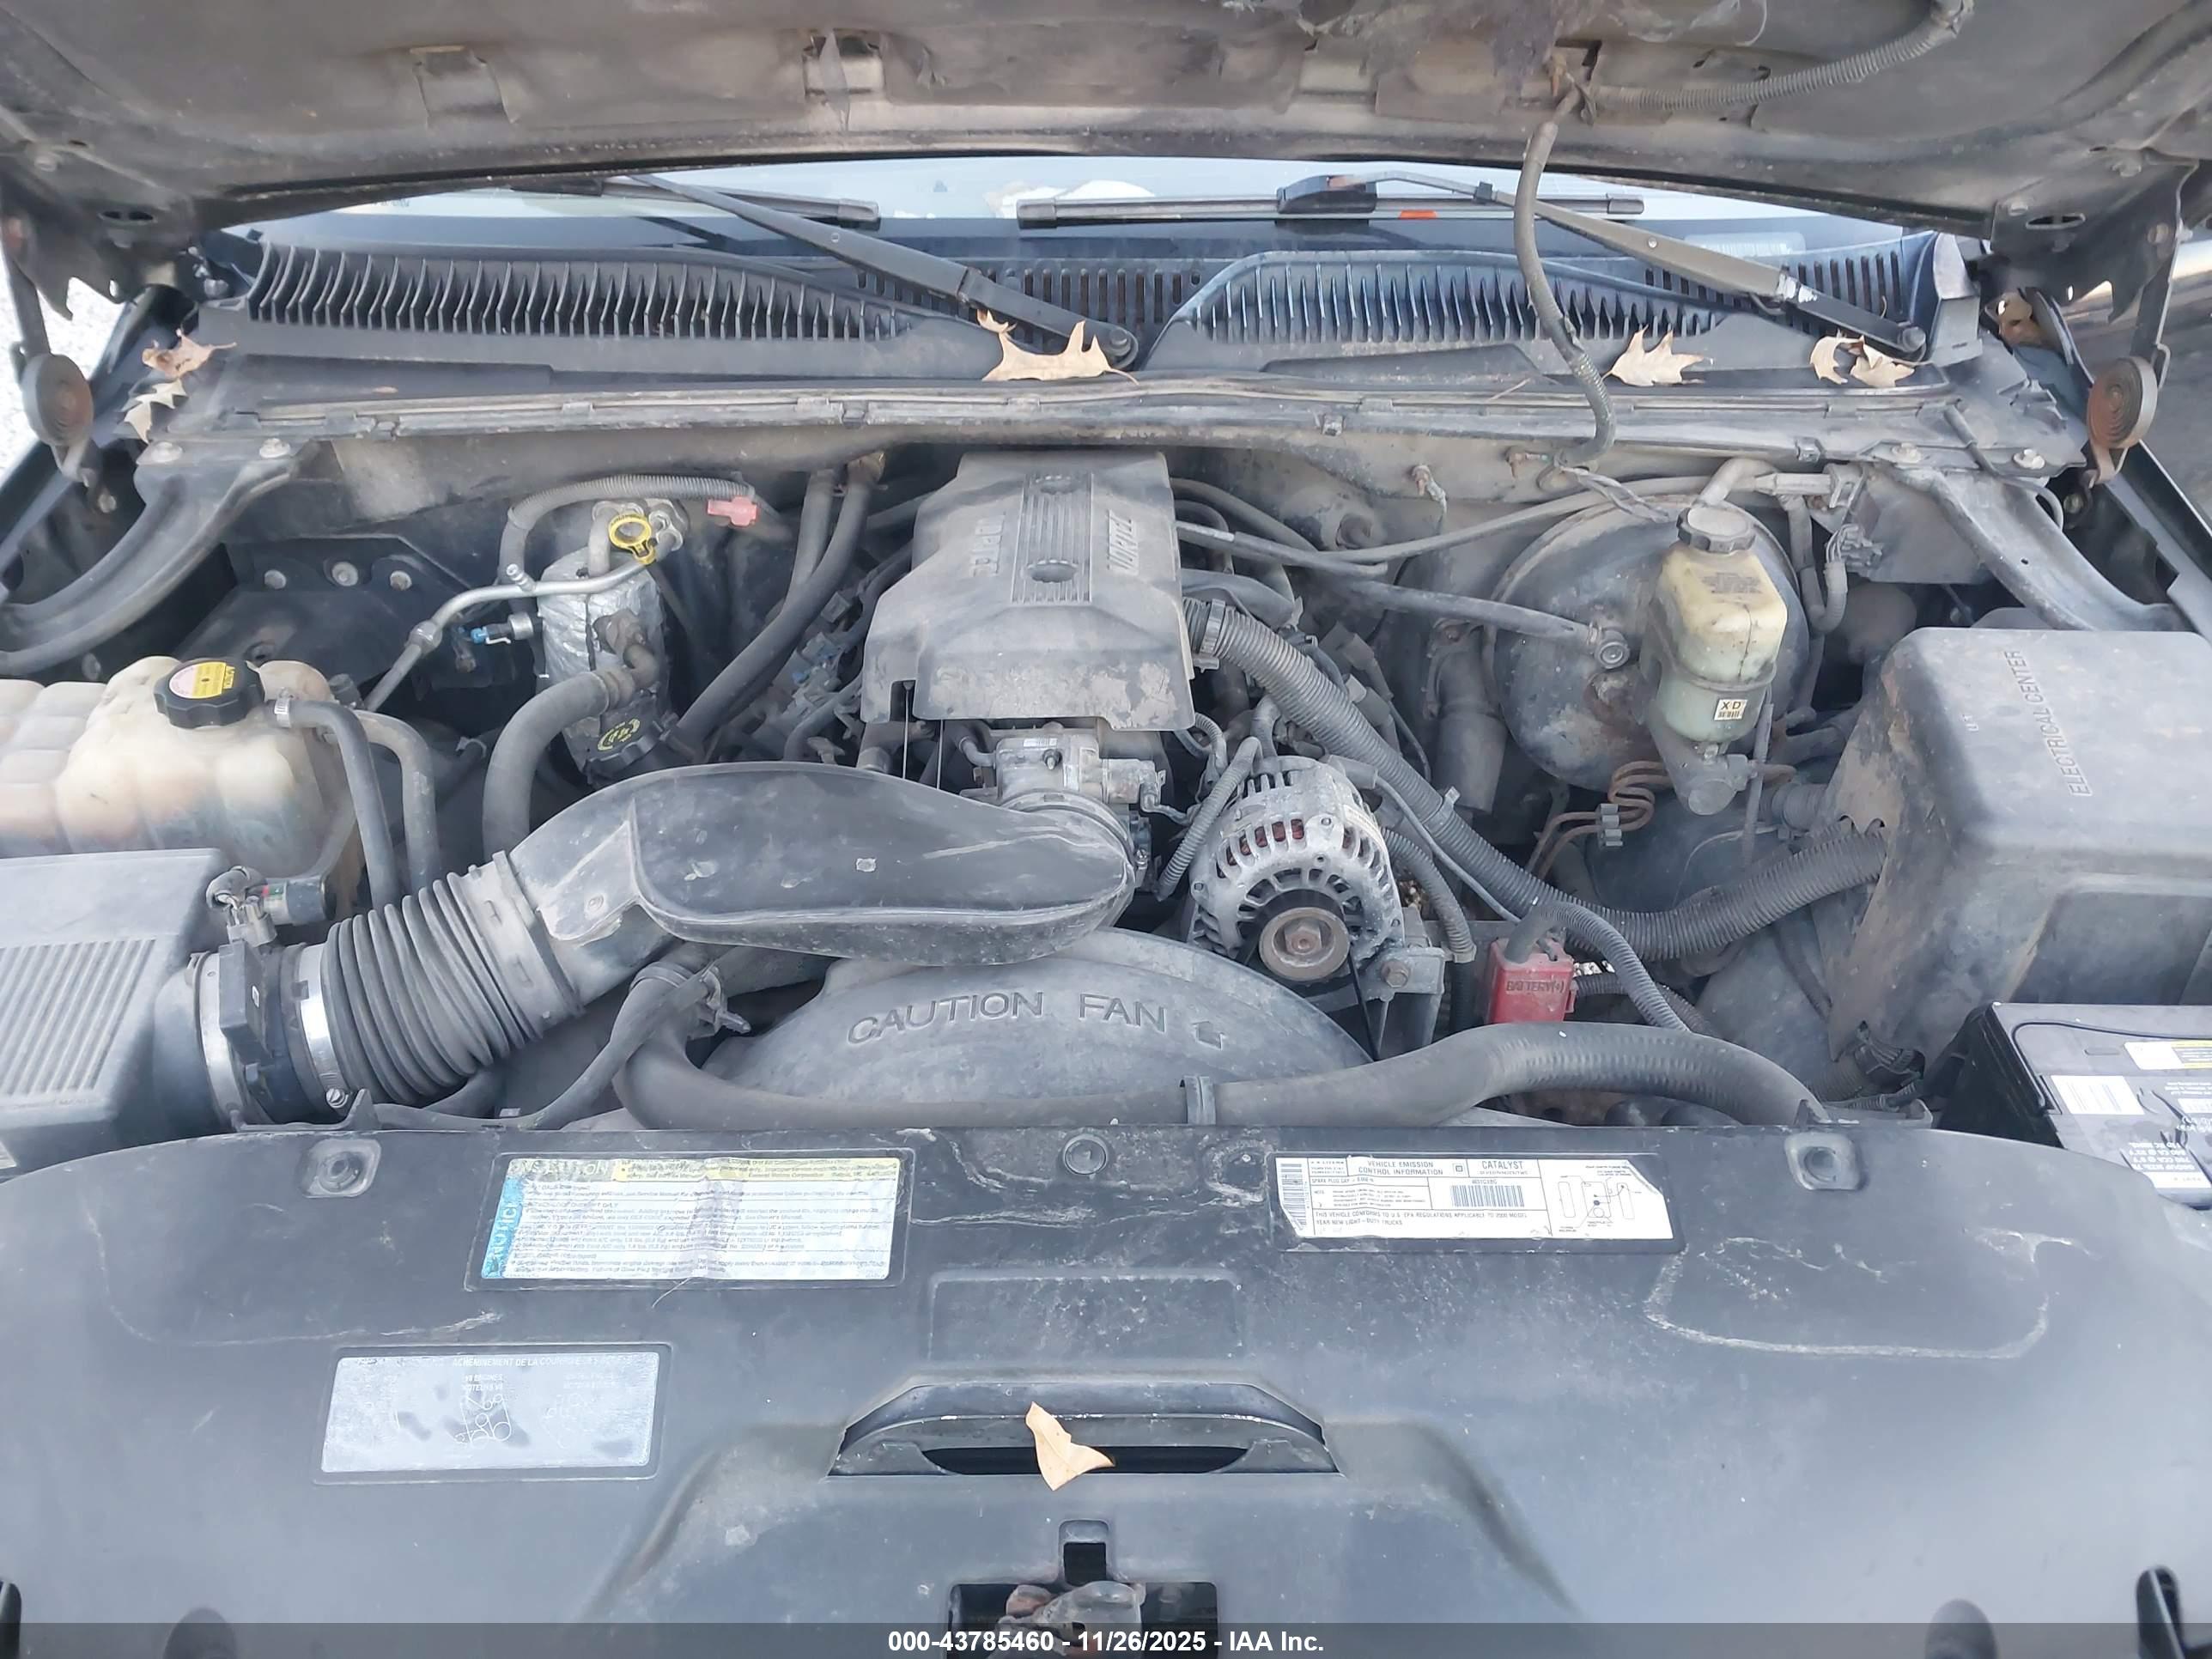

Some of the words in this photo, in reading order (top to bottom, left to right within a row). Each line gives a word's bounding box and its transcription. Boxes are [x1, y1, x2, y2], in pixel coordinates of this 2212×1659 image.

[2004, 651, 2045, 703] CENTER
[2033, 708, 2092, 794] ELECTRICAL
[847, 991, 1044, 1045] CAUTION
[1079, 993, 1167, 1034] FAN
[1358, 1167, 1390, 1176] CONTROL
[1481, 1160, 1523, 1170] CATALYST
